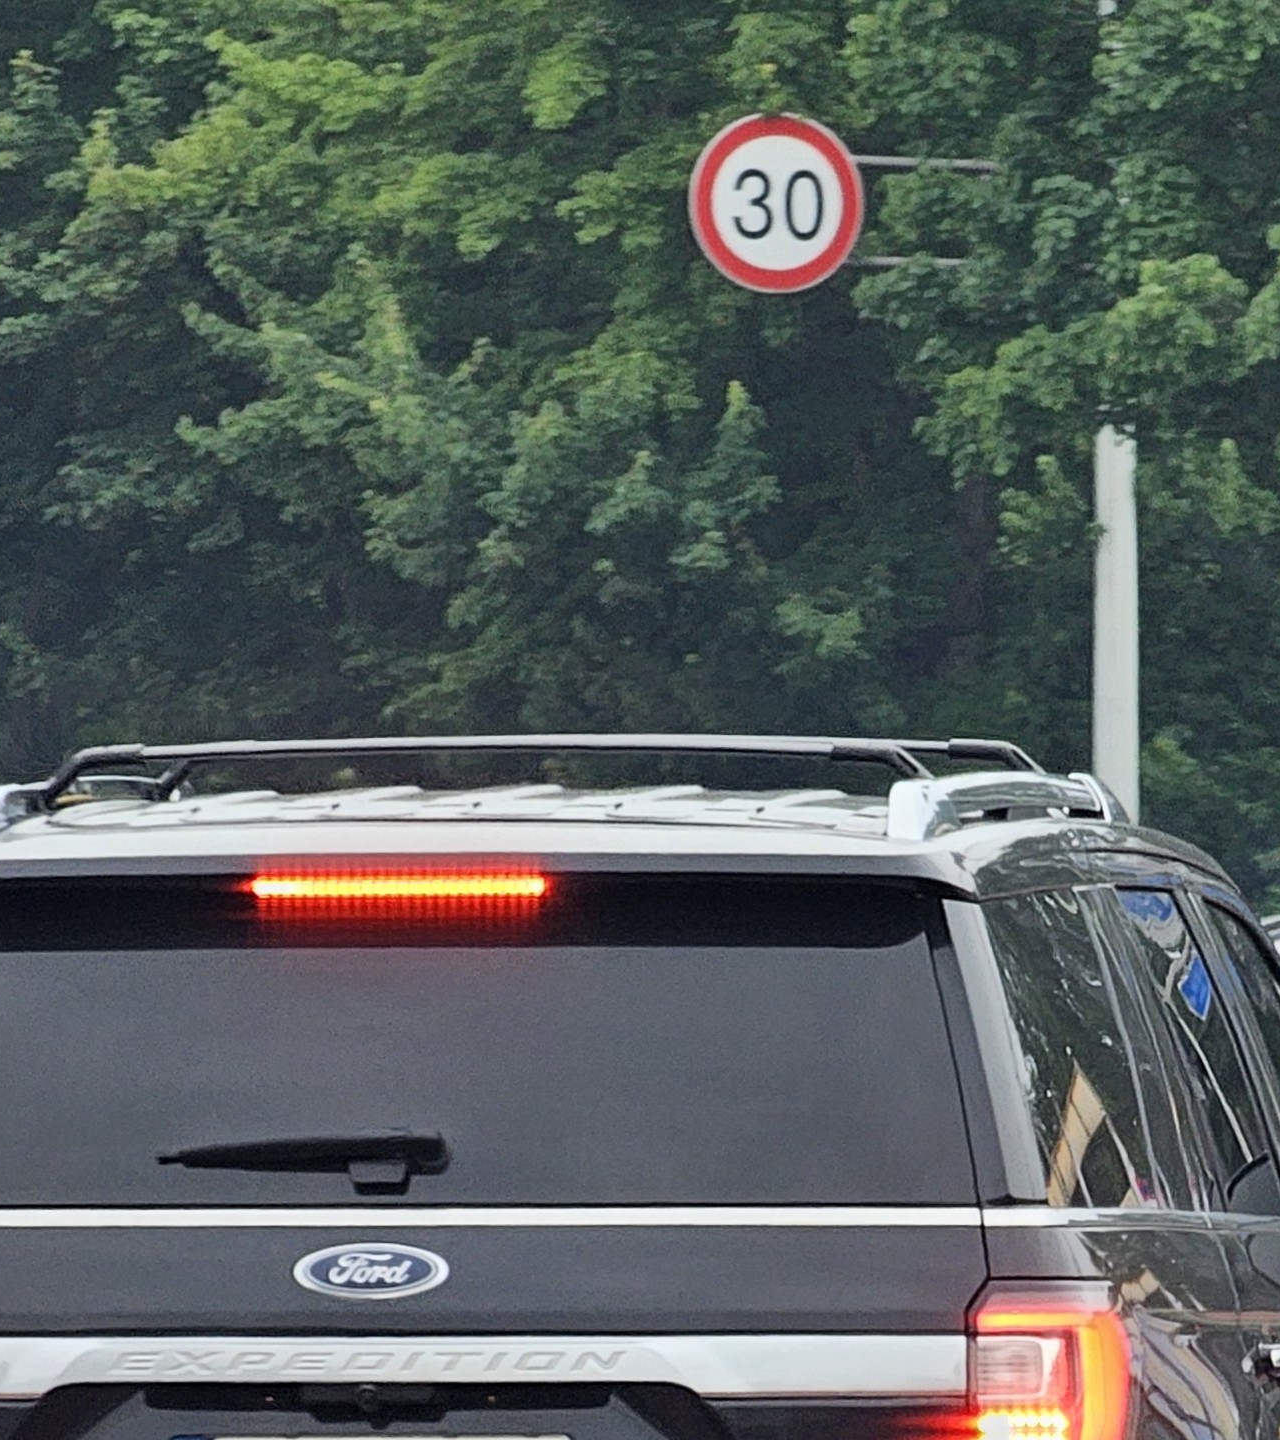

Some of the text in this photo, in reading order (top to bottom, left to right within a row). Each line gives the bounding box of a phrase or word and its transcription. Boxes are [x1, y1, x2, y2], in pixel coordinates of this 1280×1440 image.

[732, 168, 824, 240] 30
[328, 1253, 413, 1284] Ford
[105, 1350, 627, 1376] EXPEDITION
